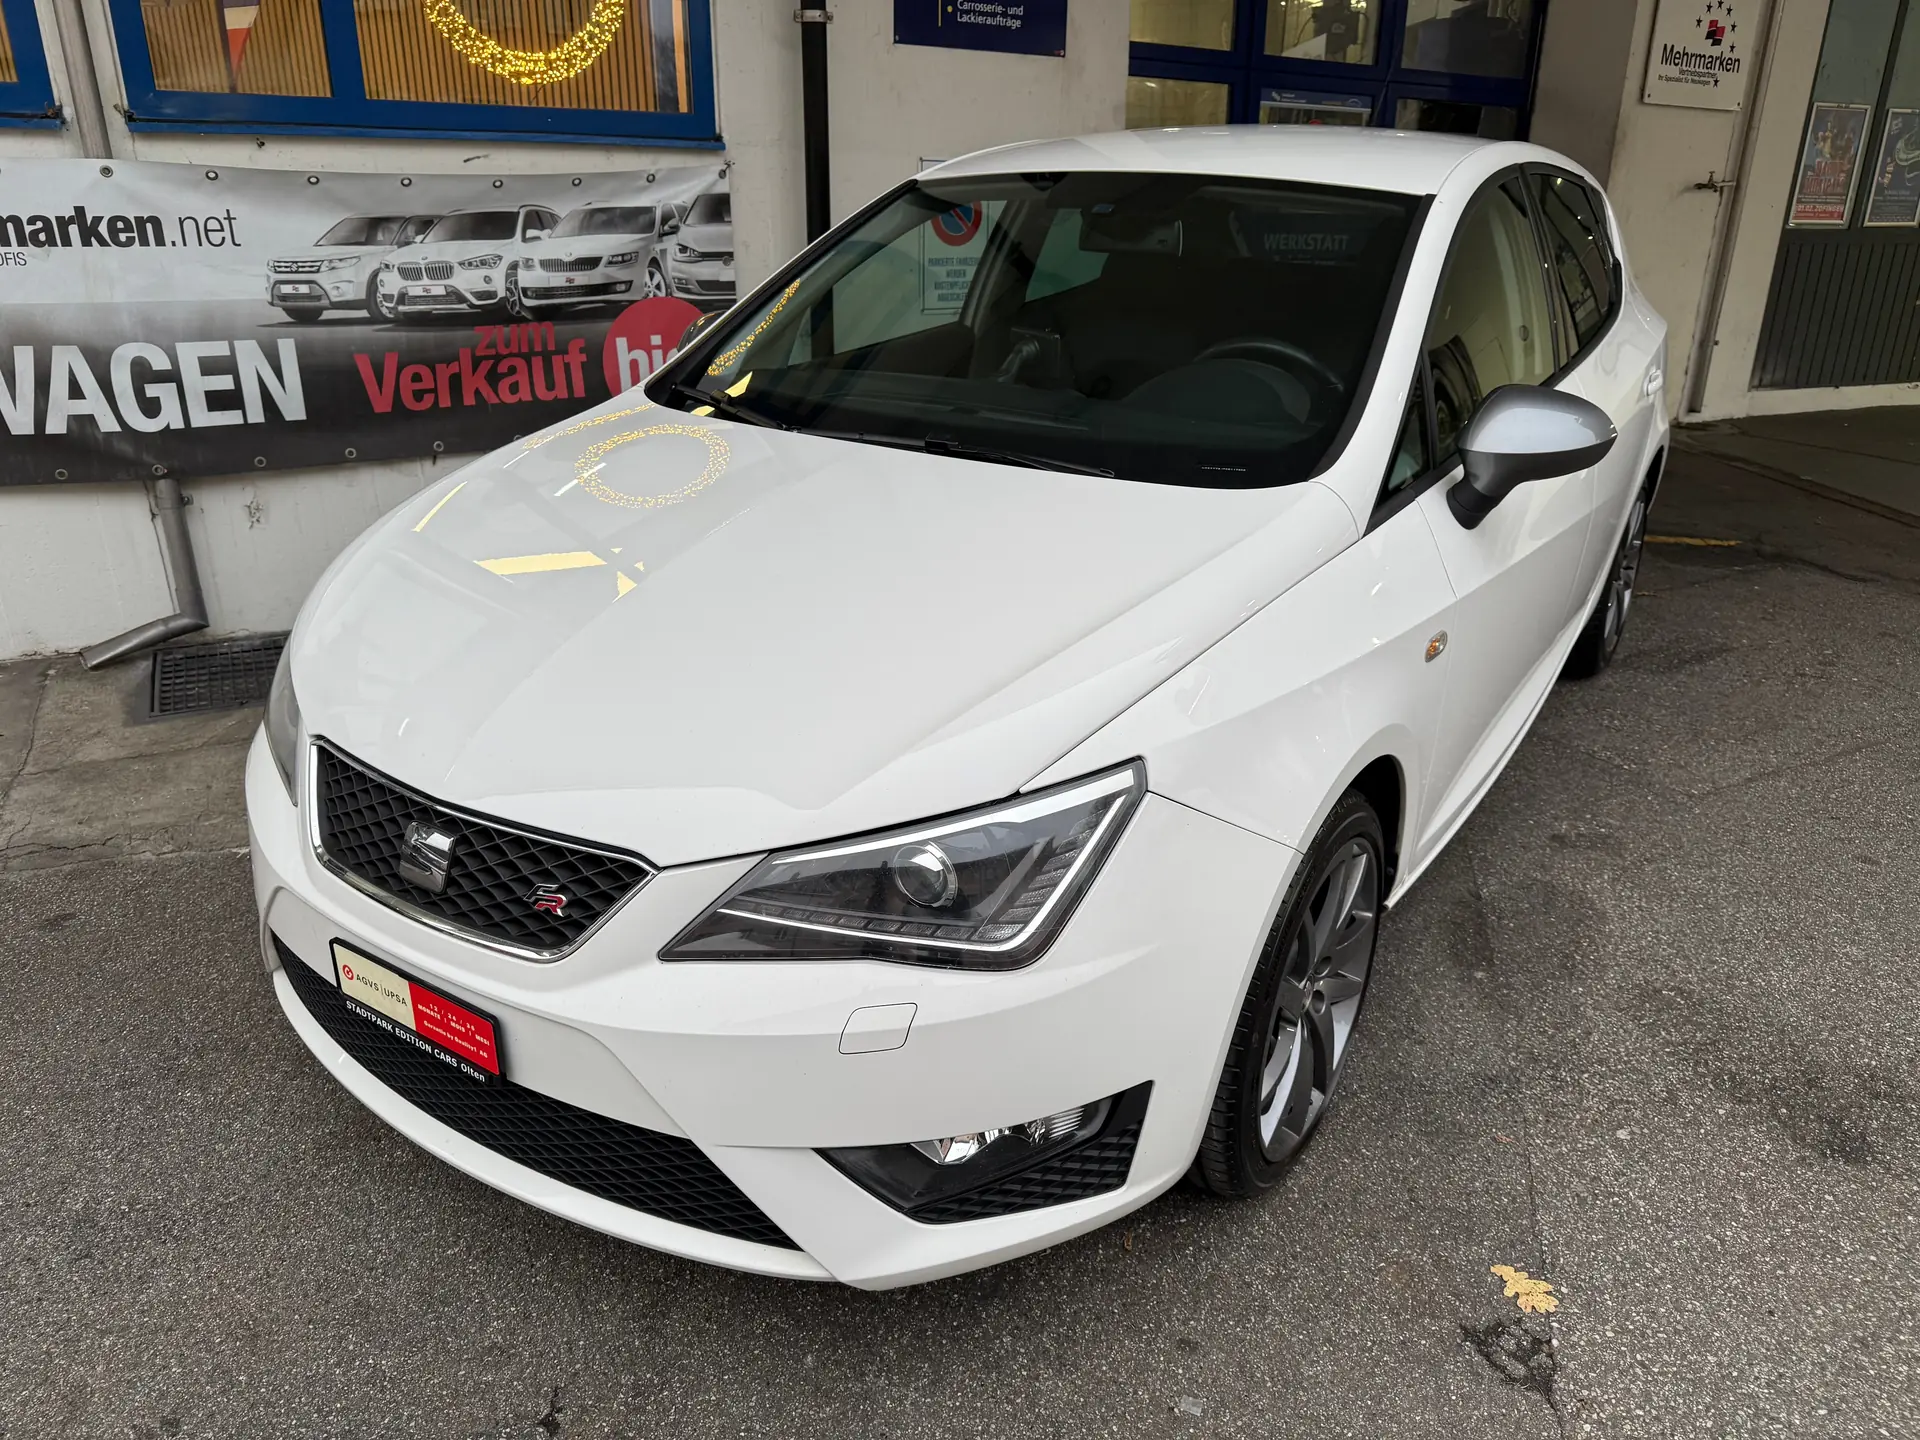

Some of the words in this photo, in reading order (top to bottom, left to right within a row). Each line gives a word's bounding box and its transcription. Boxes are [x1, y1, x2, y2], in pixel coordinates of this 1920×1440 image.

[957, 0, 1006, 13] Carrosserie-
[1007, 5, 1024, 15] und
[957, 12, 1022, 29] Lackieraufträge
[1661, 43, 1741, 73] Mehrmarken
[1263, 233, 1349, 251] WERKSTATT
[473, 321, 556, 356] zum
[0, 338, 307, 435] WAGEN
[353, 338, 588, 413] Verkauf
[417, 1003, 441, 1020] MONATE
[450, 1021, 465, 1033] MOIS
[475, 1034, 490, 1046] MESI
[423, 1020, 446, 1036] Garantie
[447, 1031, 454, 1041] by
[346, 1000, 394, 1033] STADTPARK
[395, 1027, 432, 1054] EDITION
[434, 1049, 458, 1067] CARS
[460, 1063, 485, 1082] Olten
